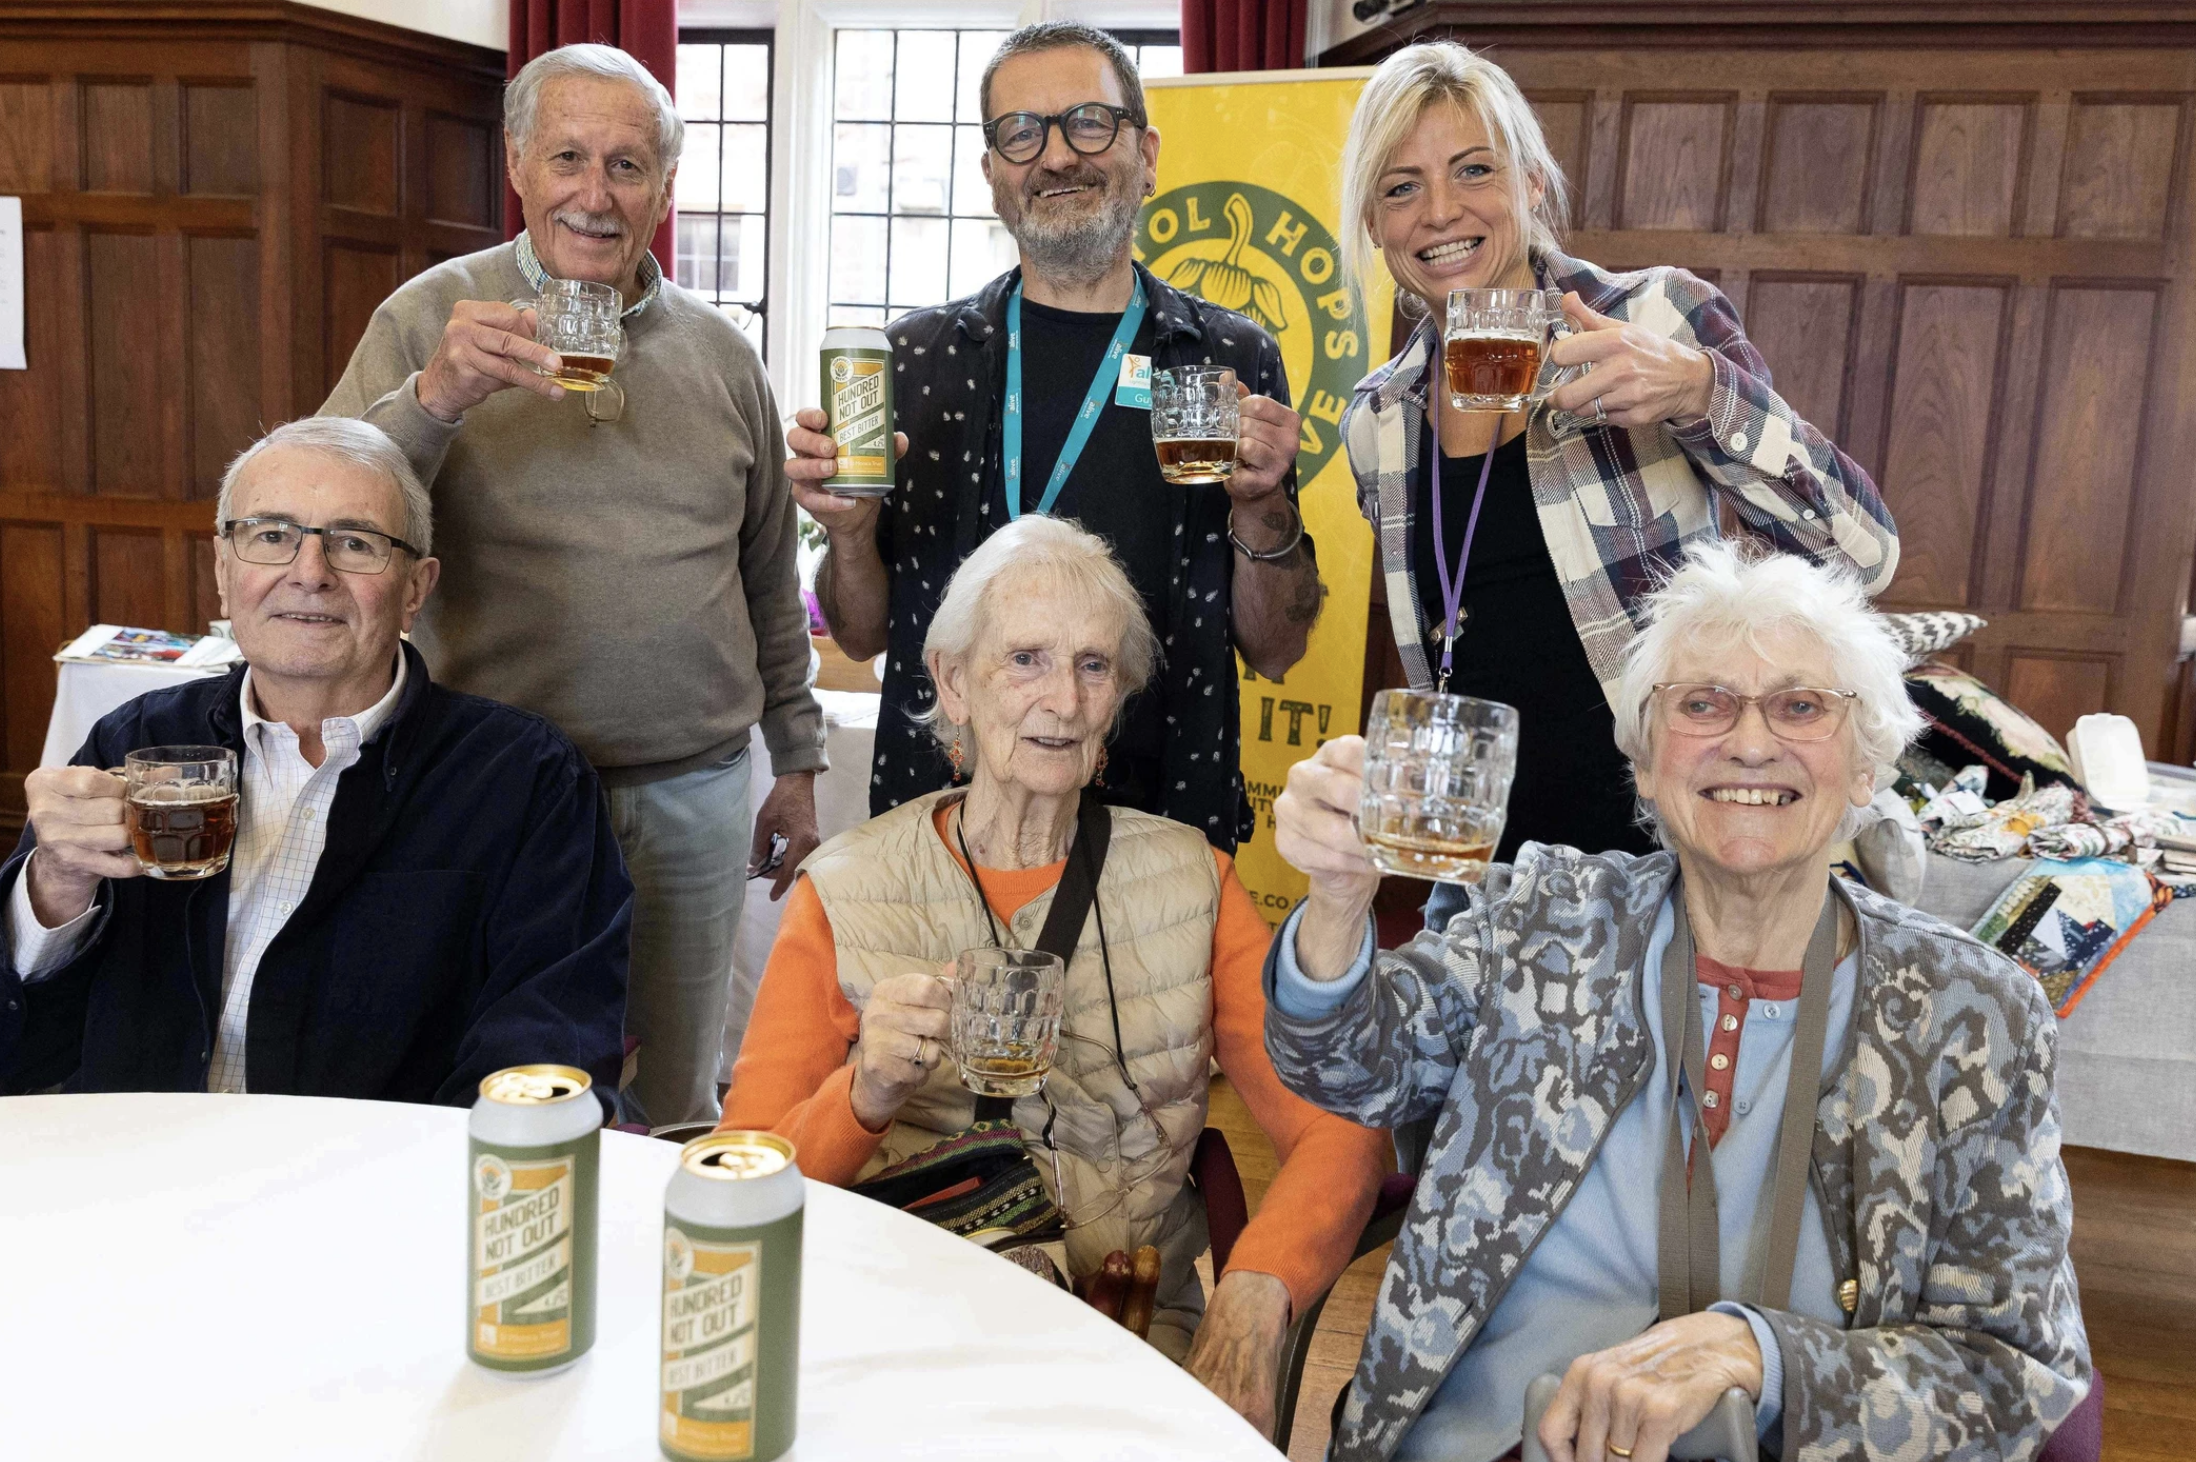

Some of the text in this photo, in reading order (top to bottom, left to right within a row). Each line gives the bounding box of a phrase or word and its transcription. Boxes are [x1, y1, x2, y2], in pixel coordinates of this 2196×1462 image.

[1265, 210, 1359, 360] HOPS
[838, 375, 879, 407] HUNDRED
[839, 390, 879, 421] NOT OUT
[839, 415, 879, 443] BEST BITTER
[1258, 696, 1332, 749] IT!
[485, 1187, 559, 1235] HUNDRED
[486, 1211, 557, 1260] NOT OUT
[670, 1273, 742, 1319] HUNDRED
[702, 1301, 739, 1337] OUT
